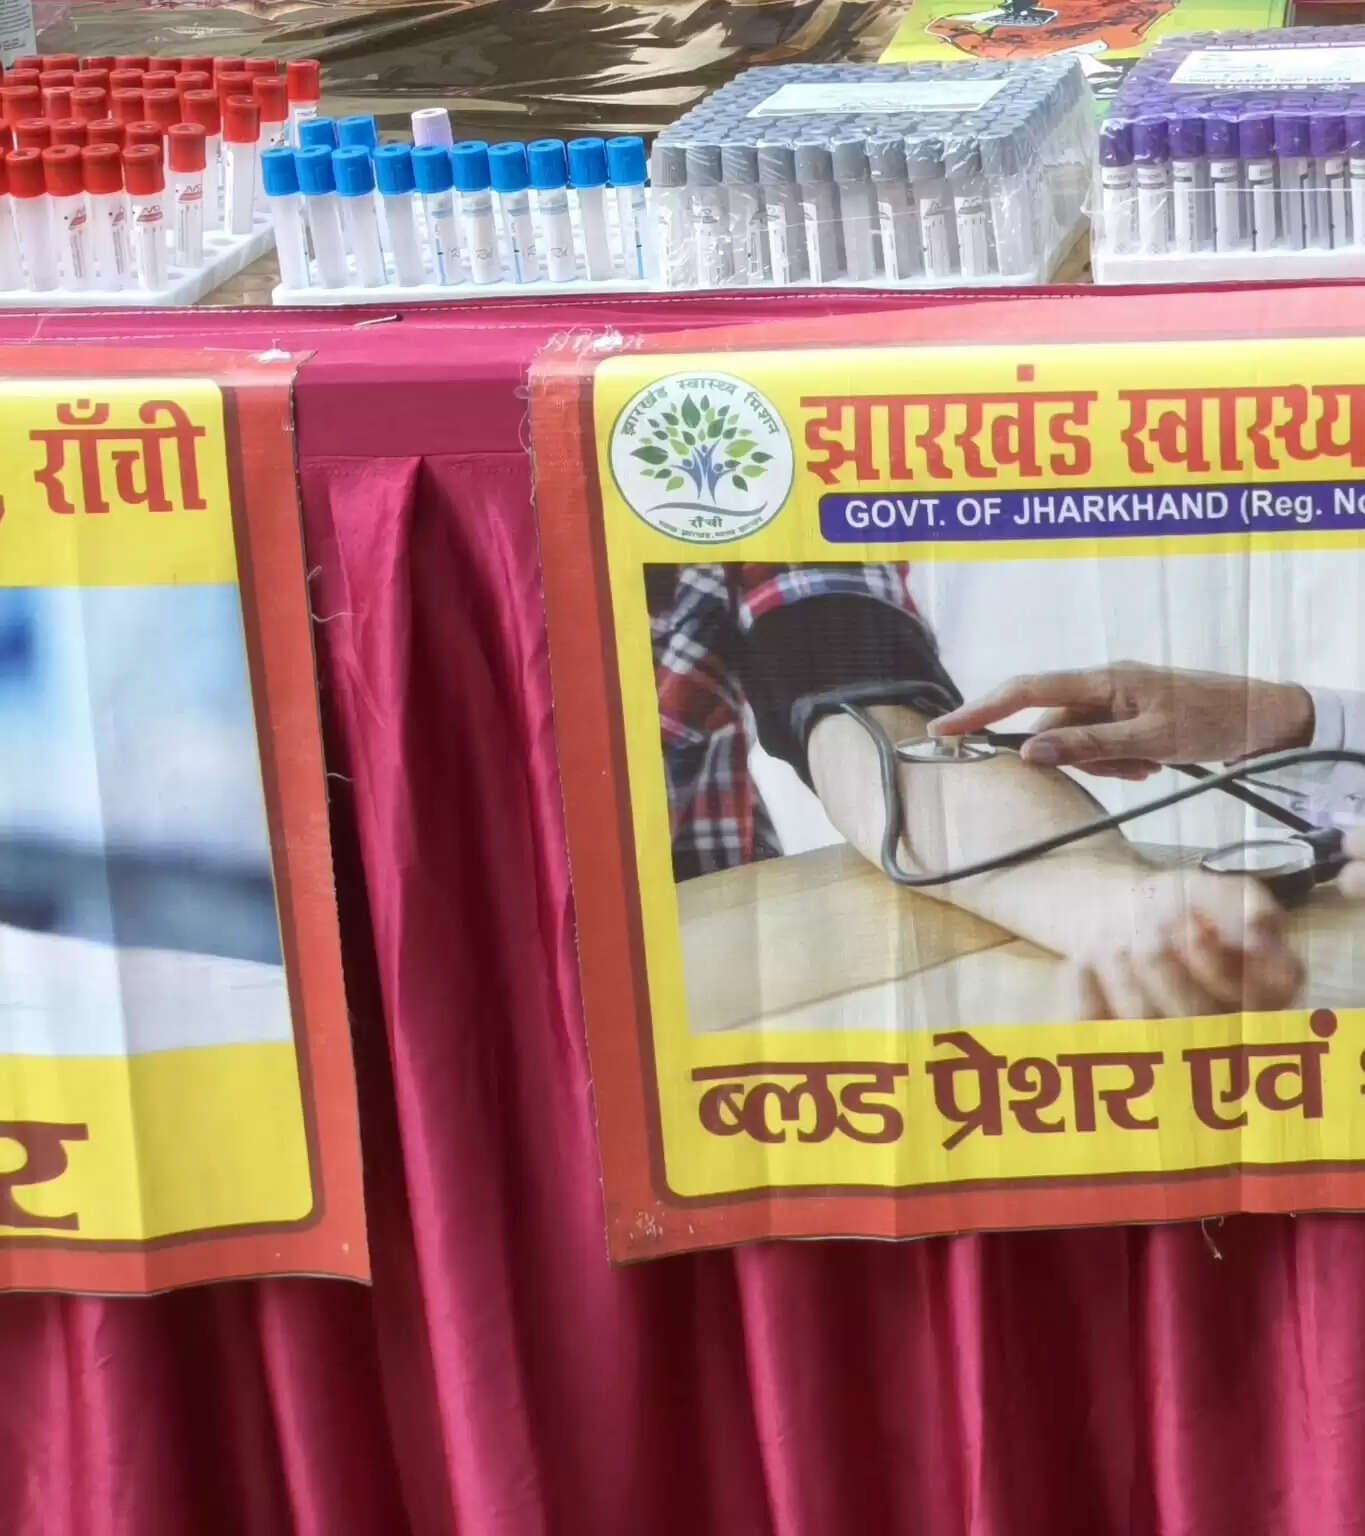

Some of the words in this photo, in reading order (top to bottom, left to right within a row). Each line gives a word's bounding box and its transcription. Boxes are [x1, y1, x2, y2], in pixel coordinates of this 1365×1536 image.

[30, 400, 206, 515] राँची
[743, 391, 779, 435] मिशन
[800, 364, 1098, 484] झारखंड
[845, 500, 944, 530] GOVT.
[956, 497, 1001, 526] OF
[1013, 491, 1228, 526] JHARKHAND
[1239, 488, 1324, 524] (Reg.
[691, 1061, 909, 1146] ब्लड
[925, 1030, 1164, 1151] प्रेशर
[1183, 1007, 1338, 1131] एवं
